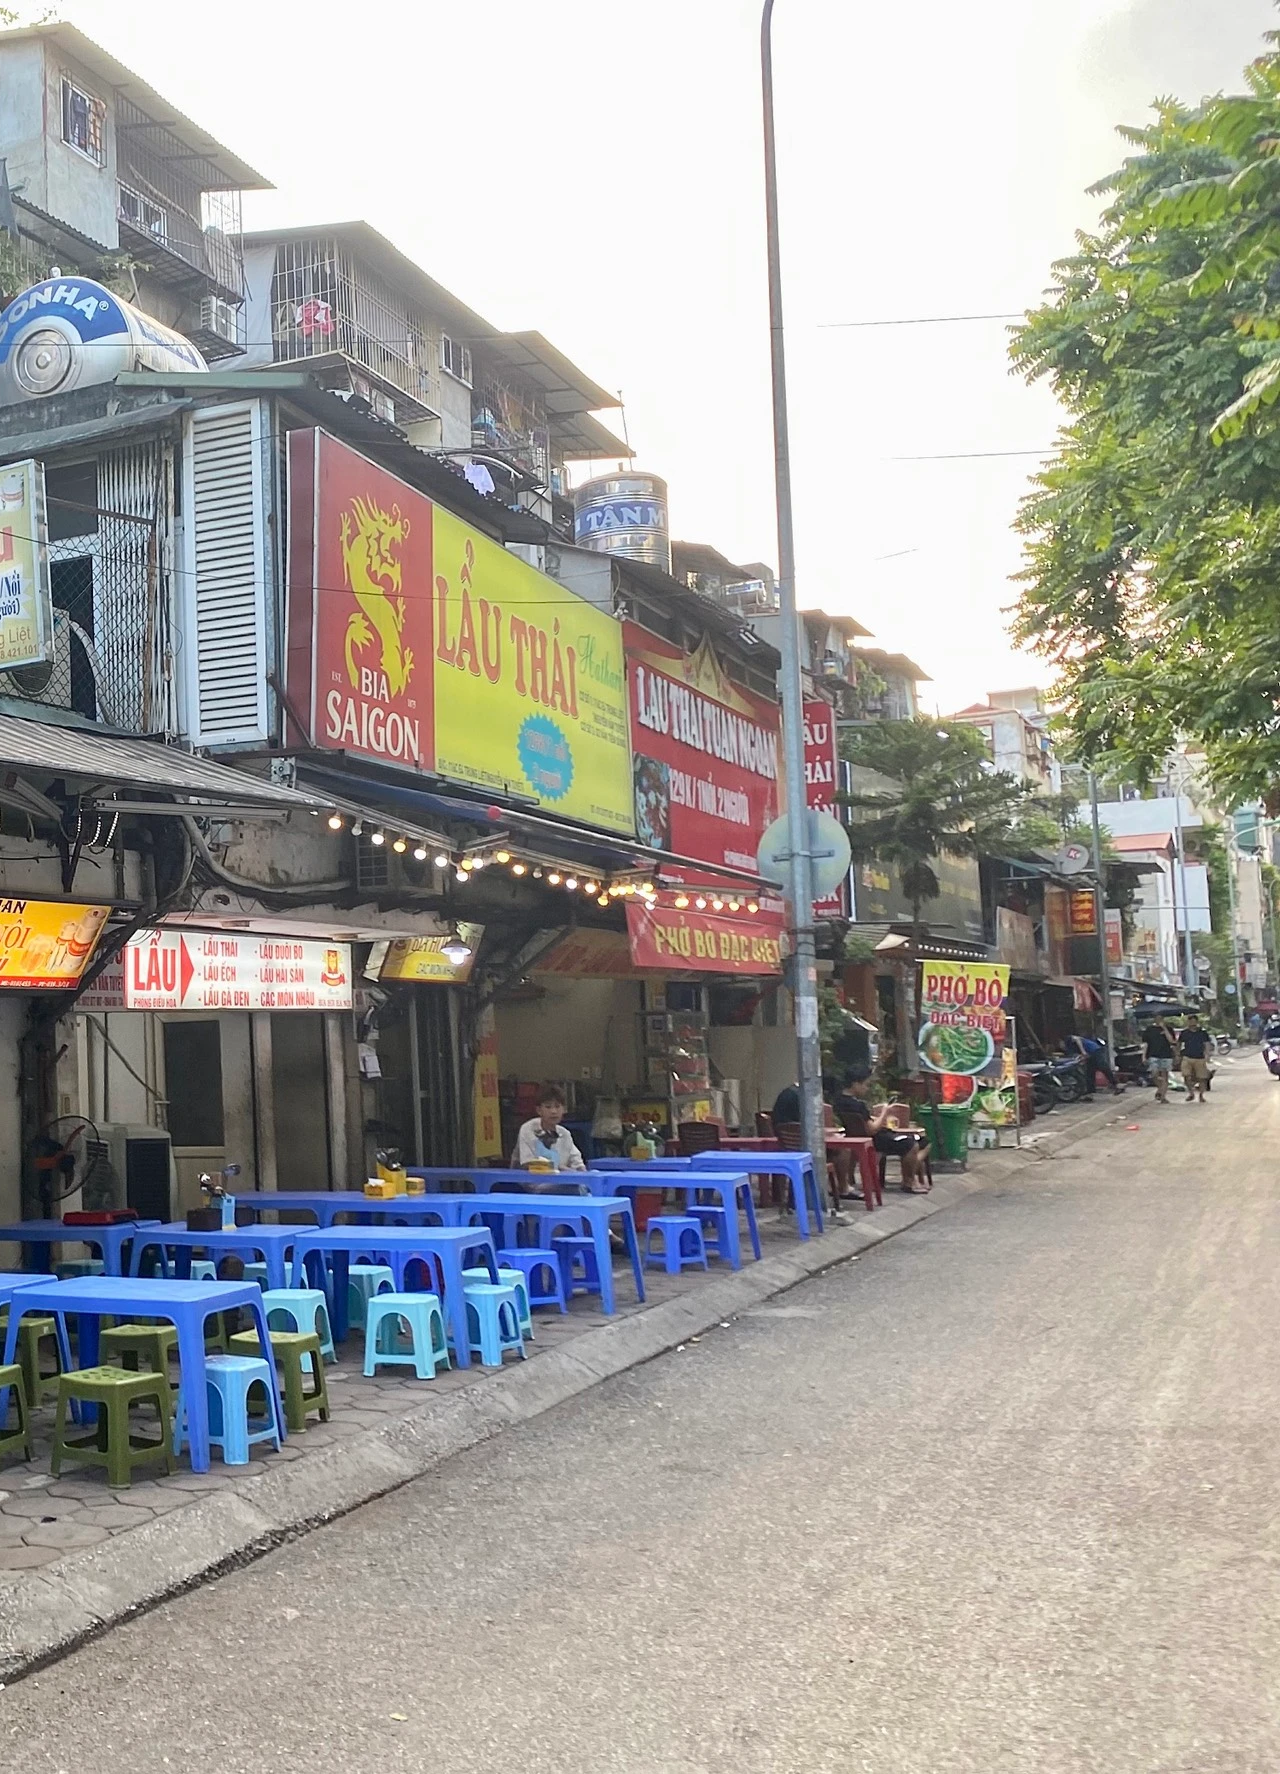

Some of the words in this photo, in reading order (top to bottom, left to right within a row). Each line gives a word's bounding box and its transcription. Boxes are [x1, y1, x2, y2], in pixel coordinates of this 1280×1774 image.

[586, 504, 641, 531] TÂN
[9, 627, 31, 645] Liệt
[436, 539, 502, 684] LẨU
[510, 617, 579, 719] THÁI
[361, 666, 390, 704] BIA
[326, 690, 419, 761] SAIGON
[803, 713, 827, 746] ẨU
[805, 755, 832, 784] HÁI
[654, 916, 691, 957] PHỞ
[694, 923, 717, 959] BÒ
[133, 928, 176, 991] LẨU
[927, 965, 969, 1004] PHỞ
[974, 970, 1002, 1007] BÒ
